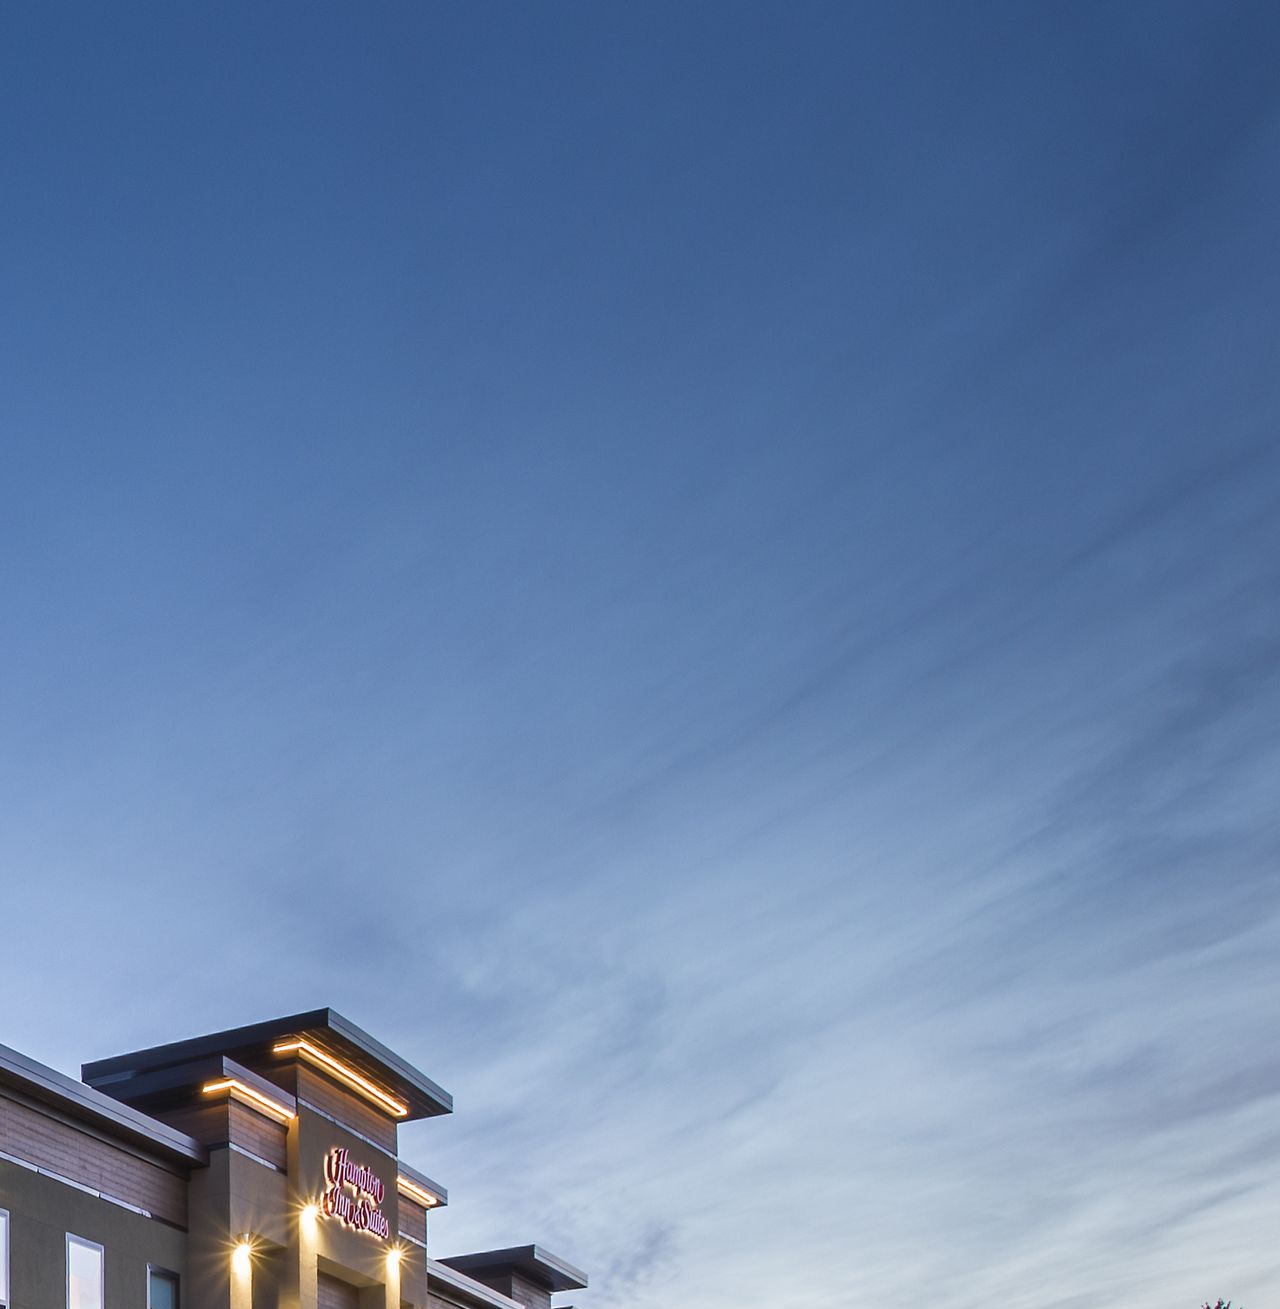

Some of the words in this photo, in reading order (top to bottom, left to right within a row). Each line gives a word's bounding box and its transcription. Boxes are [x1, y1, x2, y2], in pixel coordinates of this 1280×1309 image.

[324, 1148, 384, 1205] Hampton
[322, 1187, 356, 1225] Inn
[360, 1200, 389, 1239] Suites
